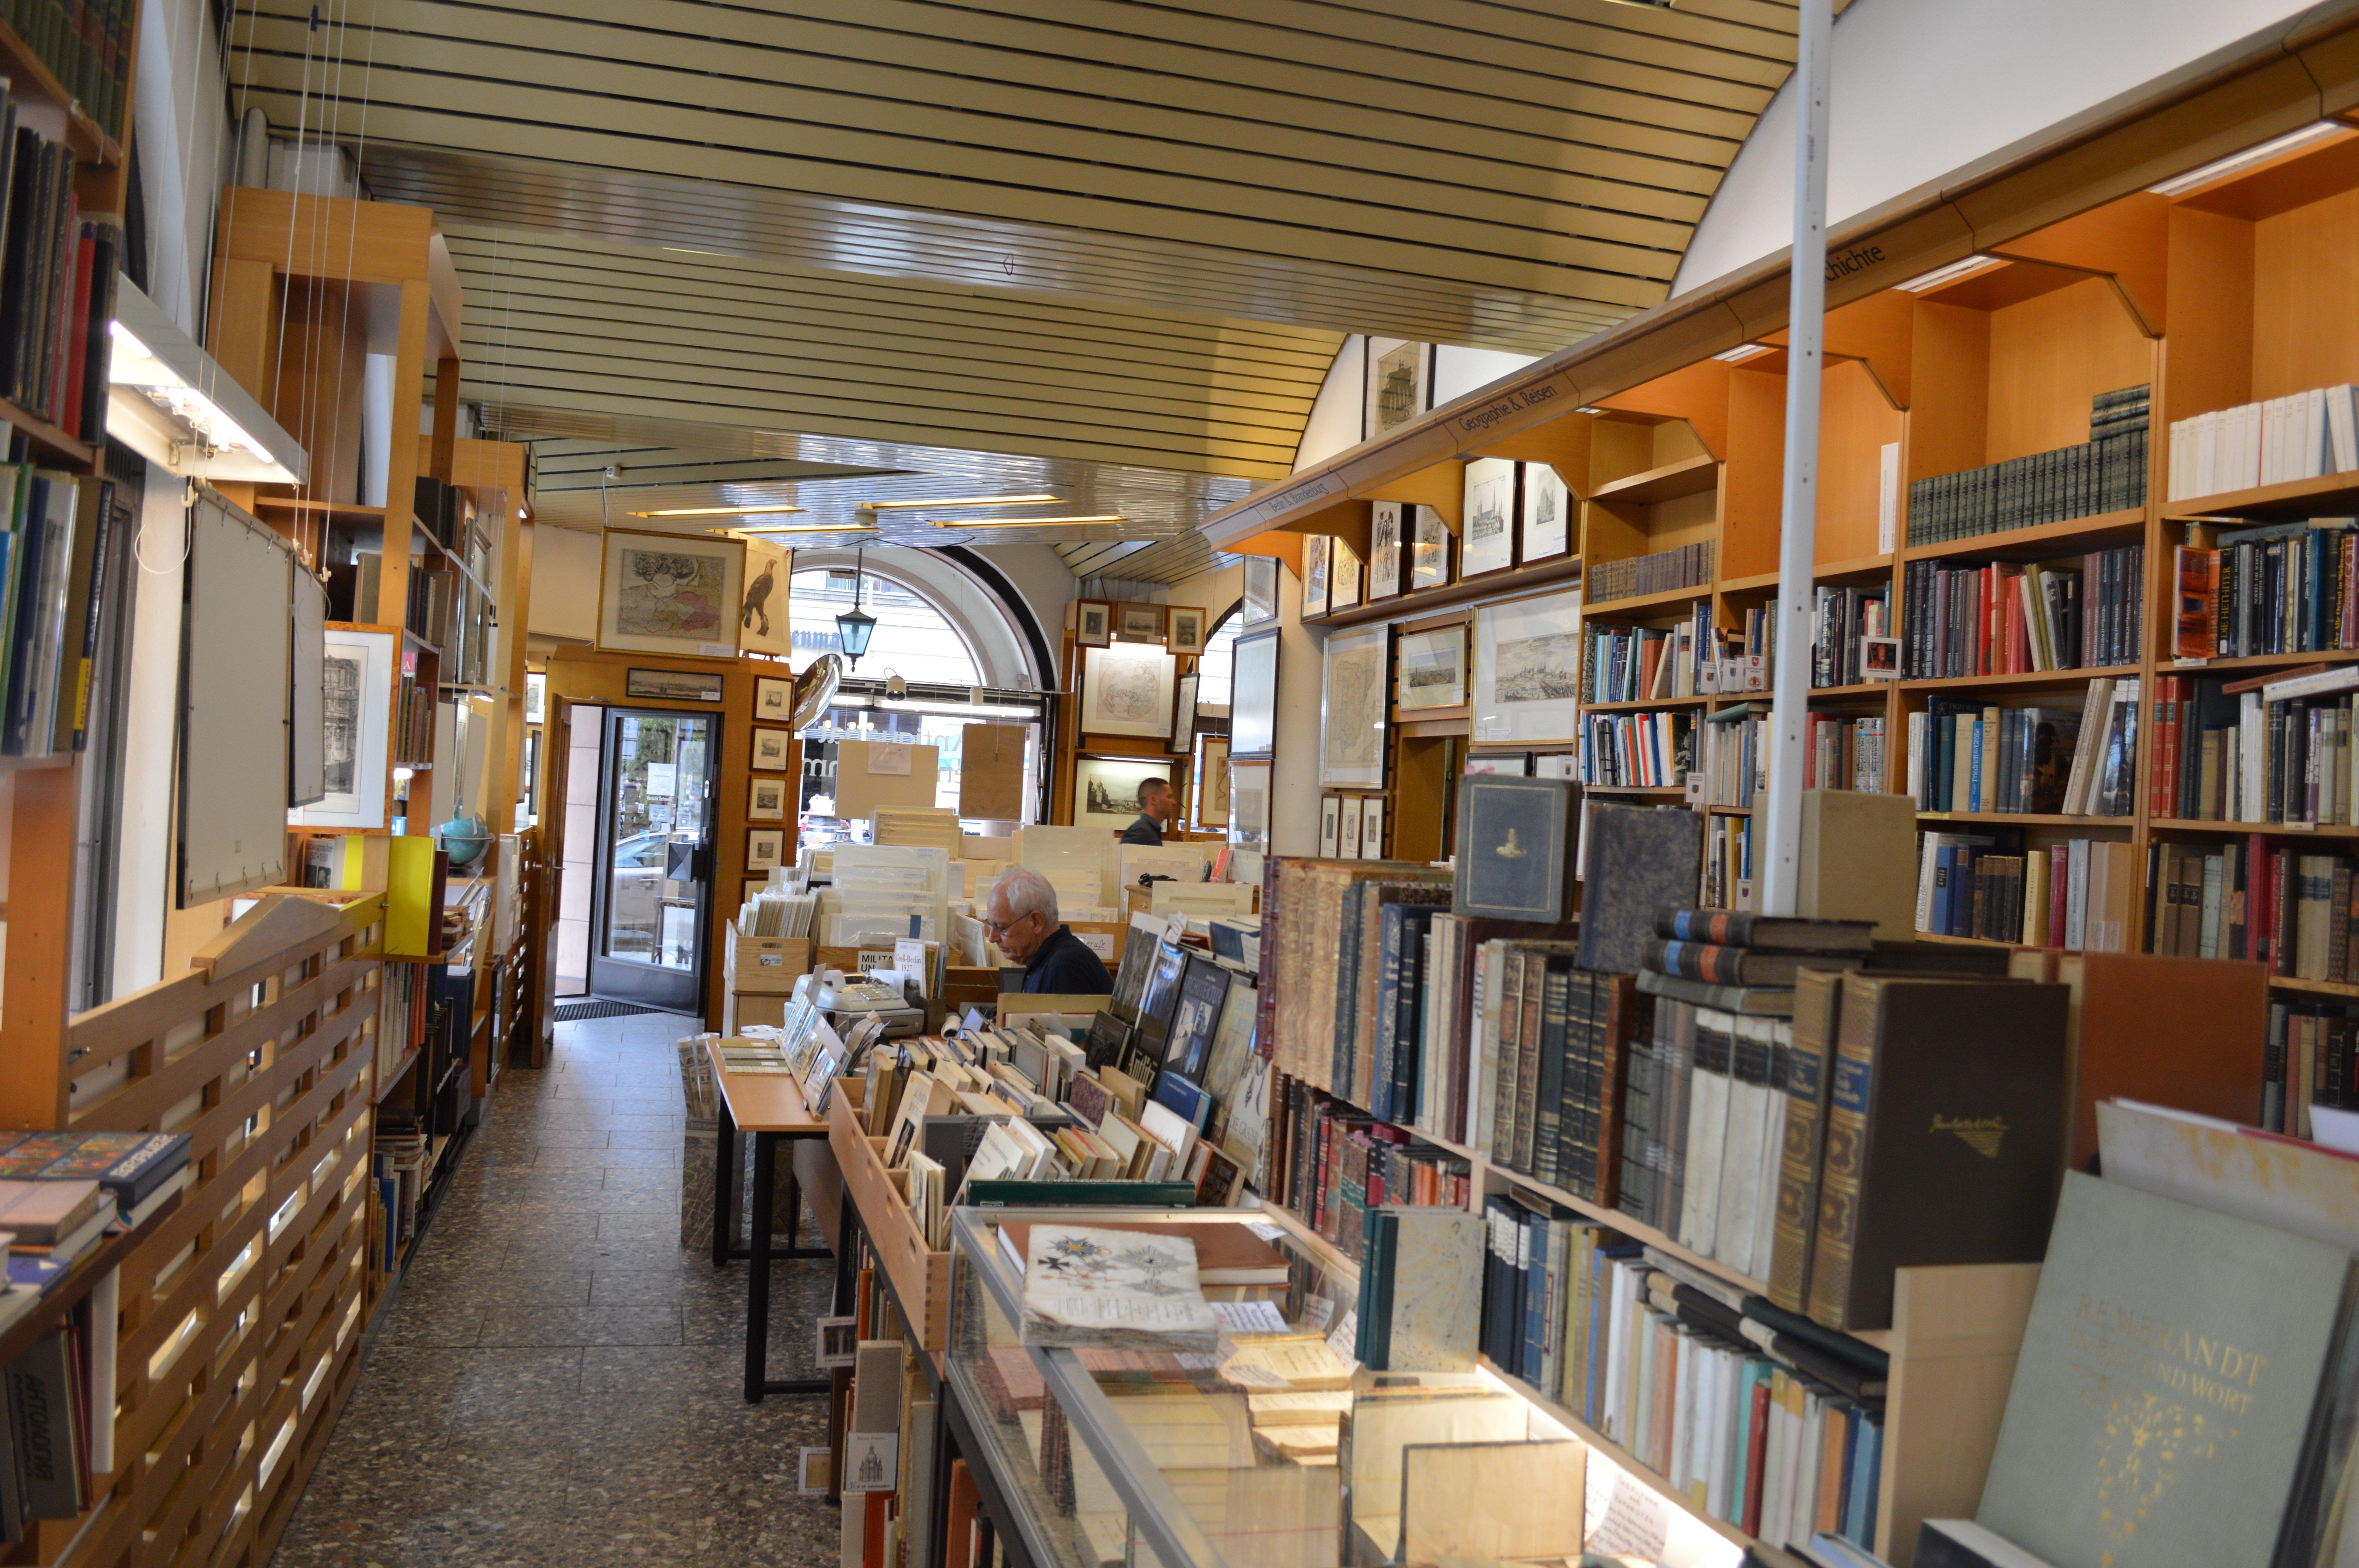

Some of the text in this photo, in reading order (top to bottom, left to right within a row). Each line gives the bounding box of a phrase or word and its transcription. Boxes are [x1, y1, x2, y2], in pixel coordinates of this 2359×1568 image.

[1459, 385, 1558, 431] Geographie & Reisen
[1268, 483, 1329, 512] Berlin & Brandenburg
[2221, 566, 2230, 619] HETHITER
[896, 954, 921, 964] Groß-Berlin
[1081, 937, 1105, 950] erufe
[2075, 1294, 2268, 1385] REMBRANDT
[2143, 1357, 2187, 1391] UND
[2191, 1375, 2255, 1418] WORT
[25, 1373, 55, 1481] АНТОЛОГИЯ
